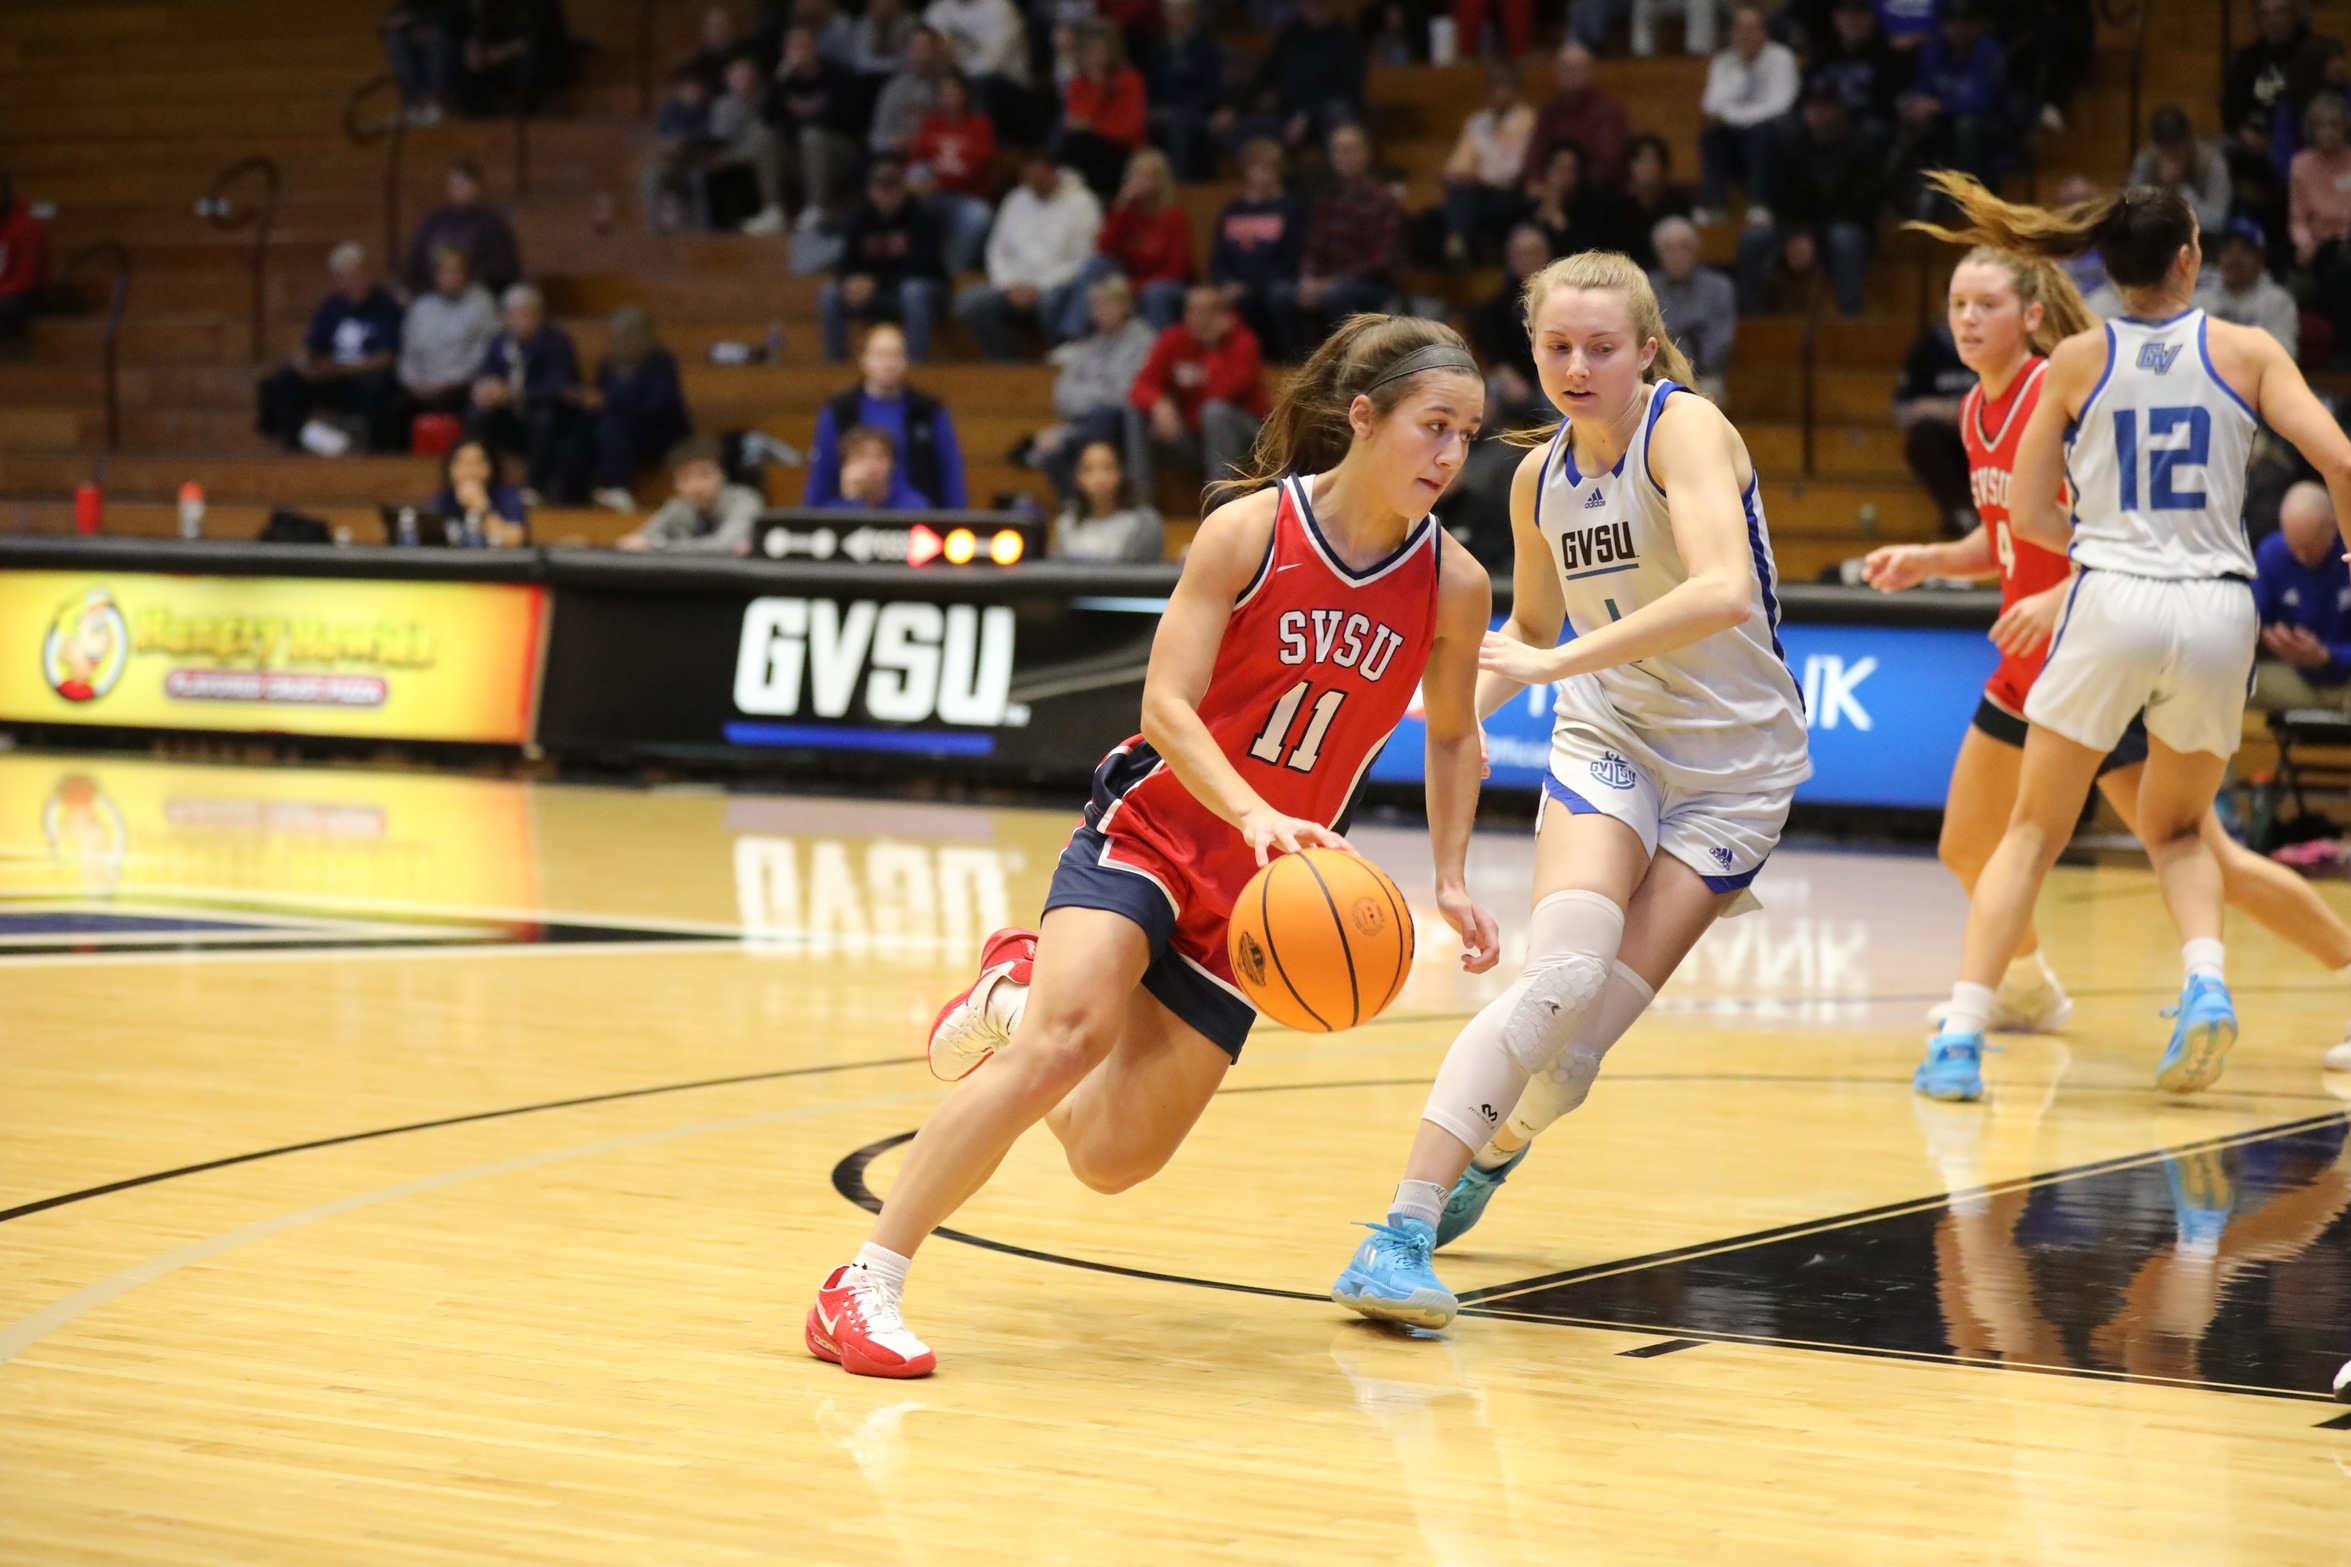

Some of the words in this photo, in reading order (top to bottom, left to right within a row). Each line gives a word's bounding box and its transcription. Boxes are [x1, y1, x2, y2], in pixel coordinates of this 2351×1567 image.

[2135, 343, 2183, 376] GV
[2113, 406, 2211, 512] 12
[1584, 499, 1606, 509] adidas
[1562, 521, 1636, 570] GVSU
[733, 596, 1016, 726] GVSU
[1278, 609, 1406, 682] SVSU
[1247, 680, 1348, 774] 11
[1709, 848, 1731, 871] adidas
